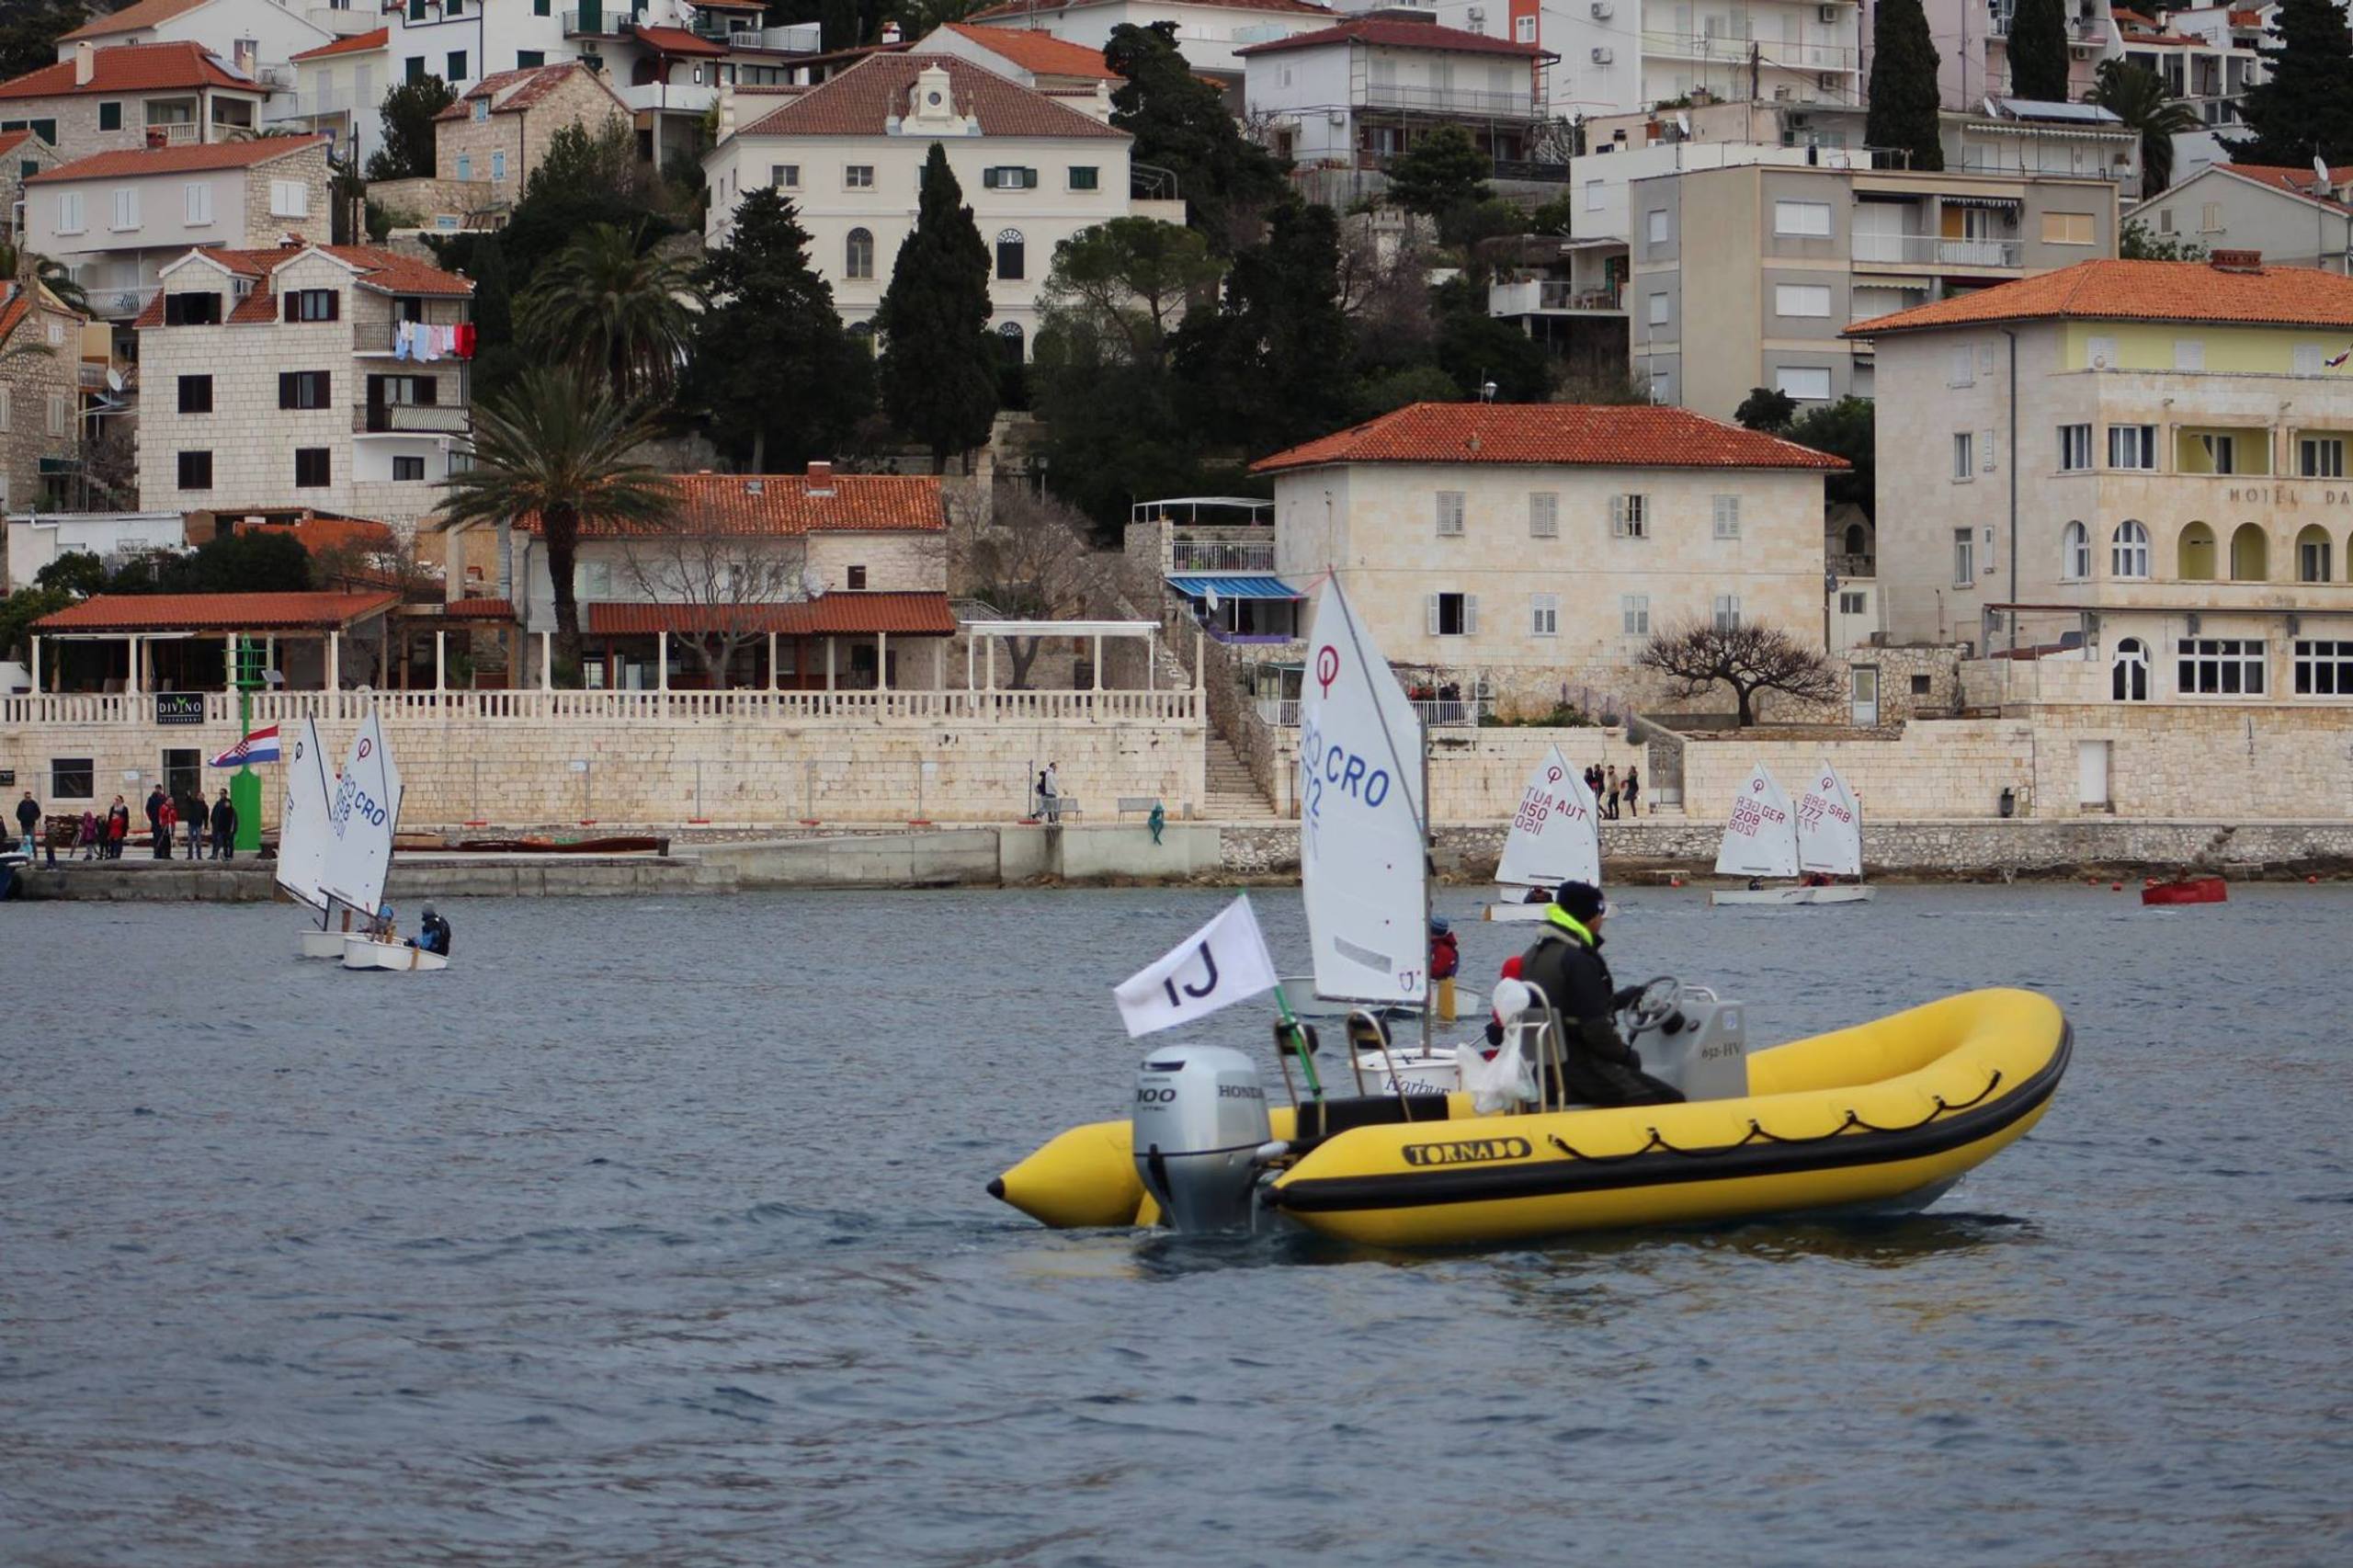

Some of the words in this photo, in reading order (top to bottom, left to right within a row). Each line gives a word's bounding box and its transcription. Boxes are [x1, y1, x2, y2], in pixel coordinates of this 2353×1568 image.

[1325, 745, 1390, 808] CRO
[355, 791, 385, 826] CRO
[1519, 801, 1548, 821] 1150
[1555, 799, 1586, 821] AUT
[1733, 808, 1761, 825] 1208
[1762, 805, 1786, 824] GER
[1799, 803, 1823, 821] 777
[1828, 803, 1851, 824] SRB
[1137, 1088, 1176, 1103] 100
[1219, 1085, 1265, 1099] HONDA
[1410, 1139, 1524, 1165] TORNADO
